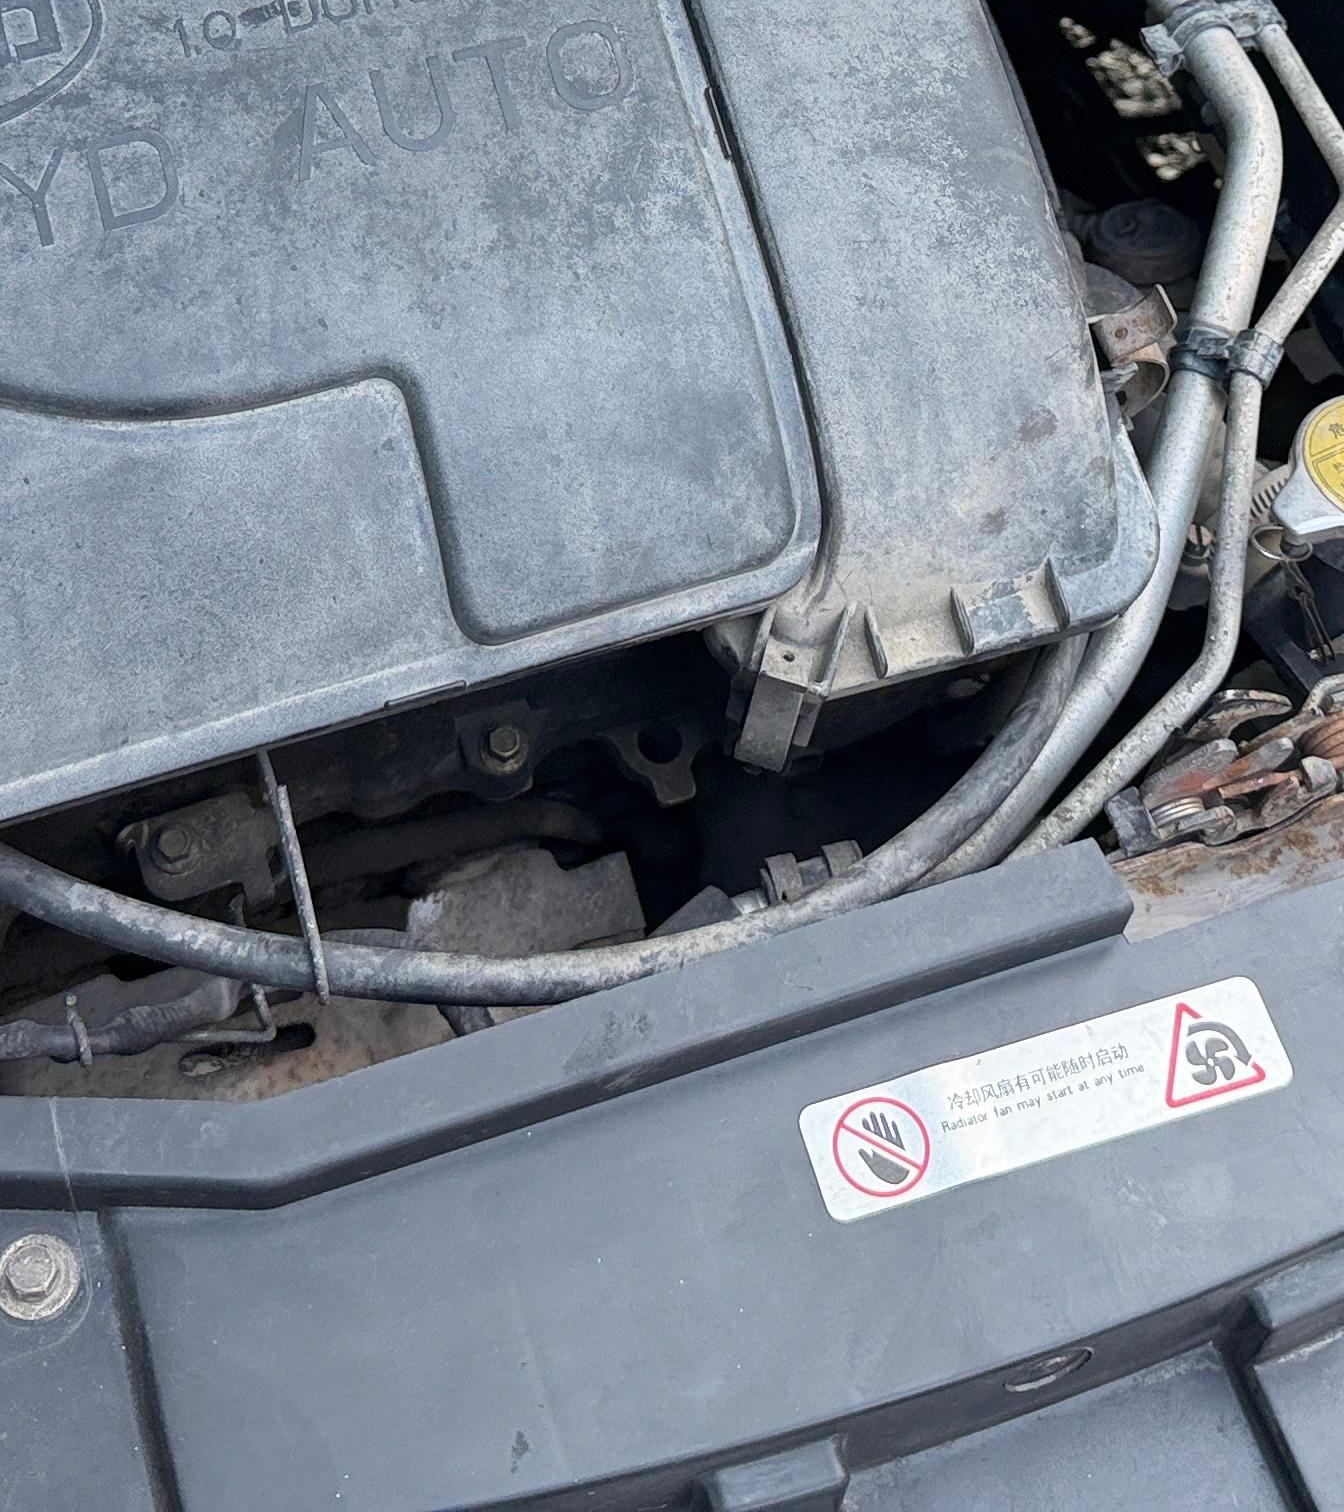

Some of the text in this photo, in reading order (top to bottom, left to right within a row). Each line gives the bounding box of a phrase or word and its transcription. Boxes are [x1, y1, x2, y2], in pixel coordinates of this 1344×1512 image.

[296, 18, 633, 182] AUTO
[941, 1064, 1145, 1133] Radiator fan may start at any time
[947, 1042, 1130, 1111] 冷却风扇有可能随时启动
